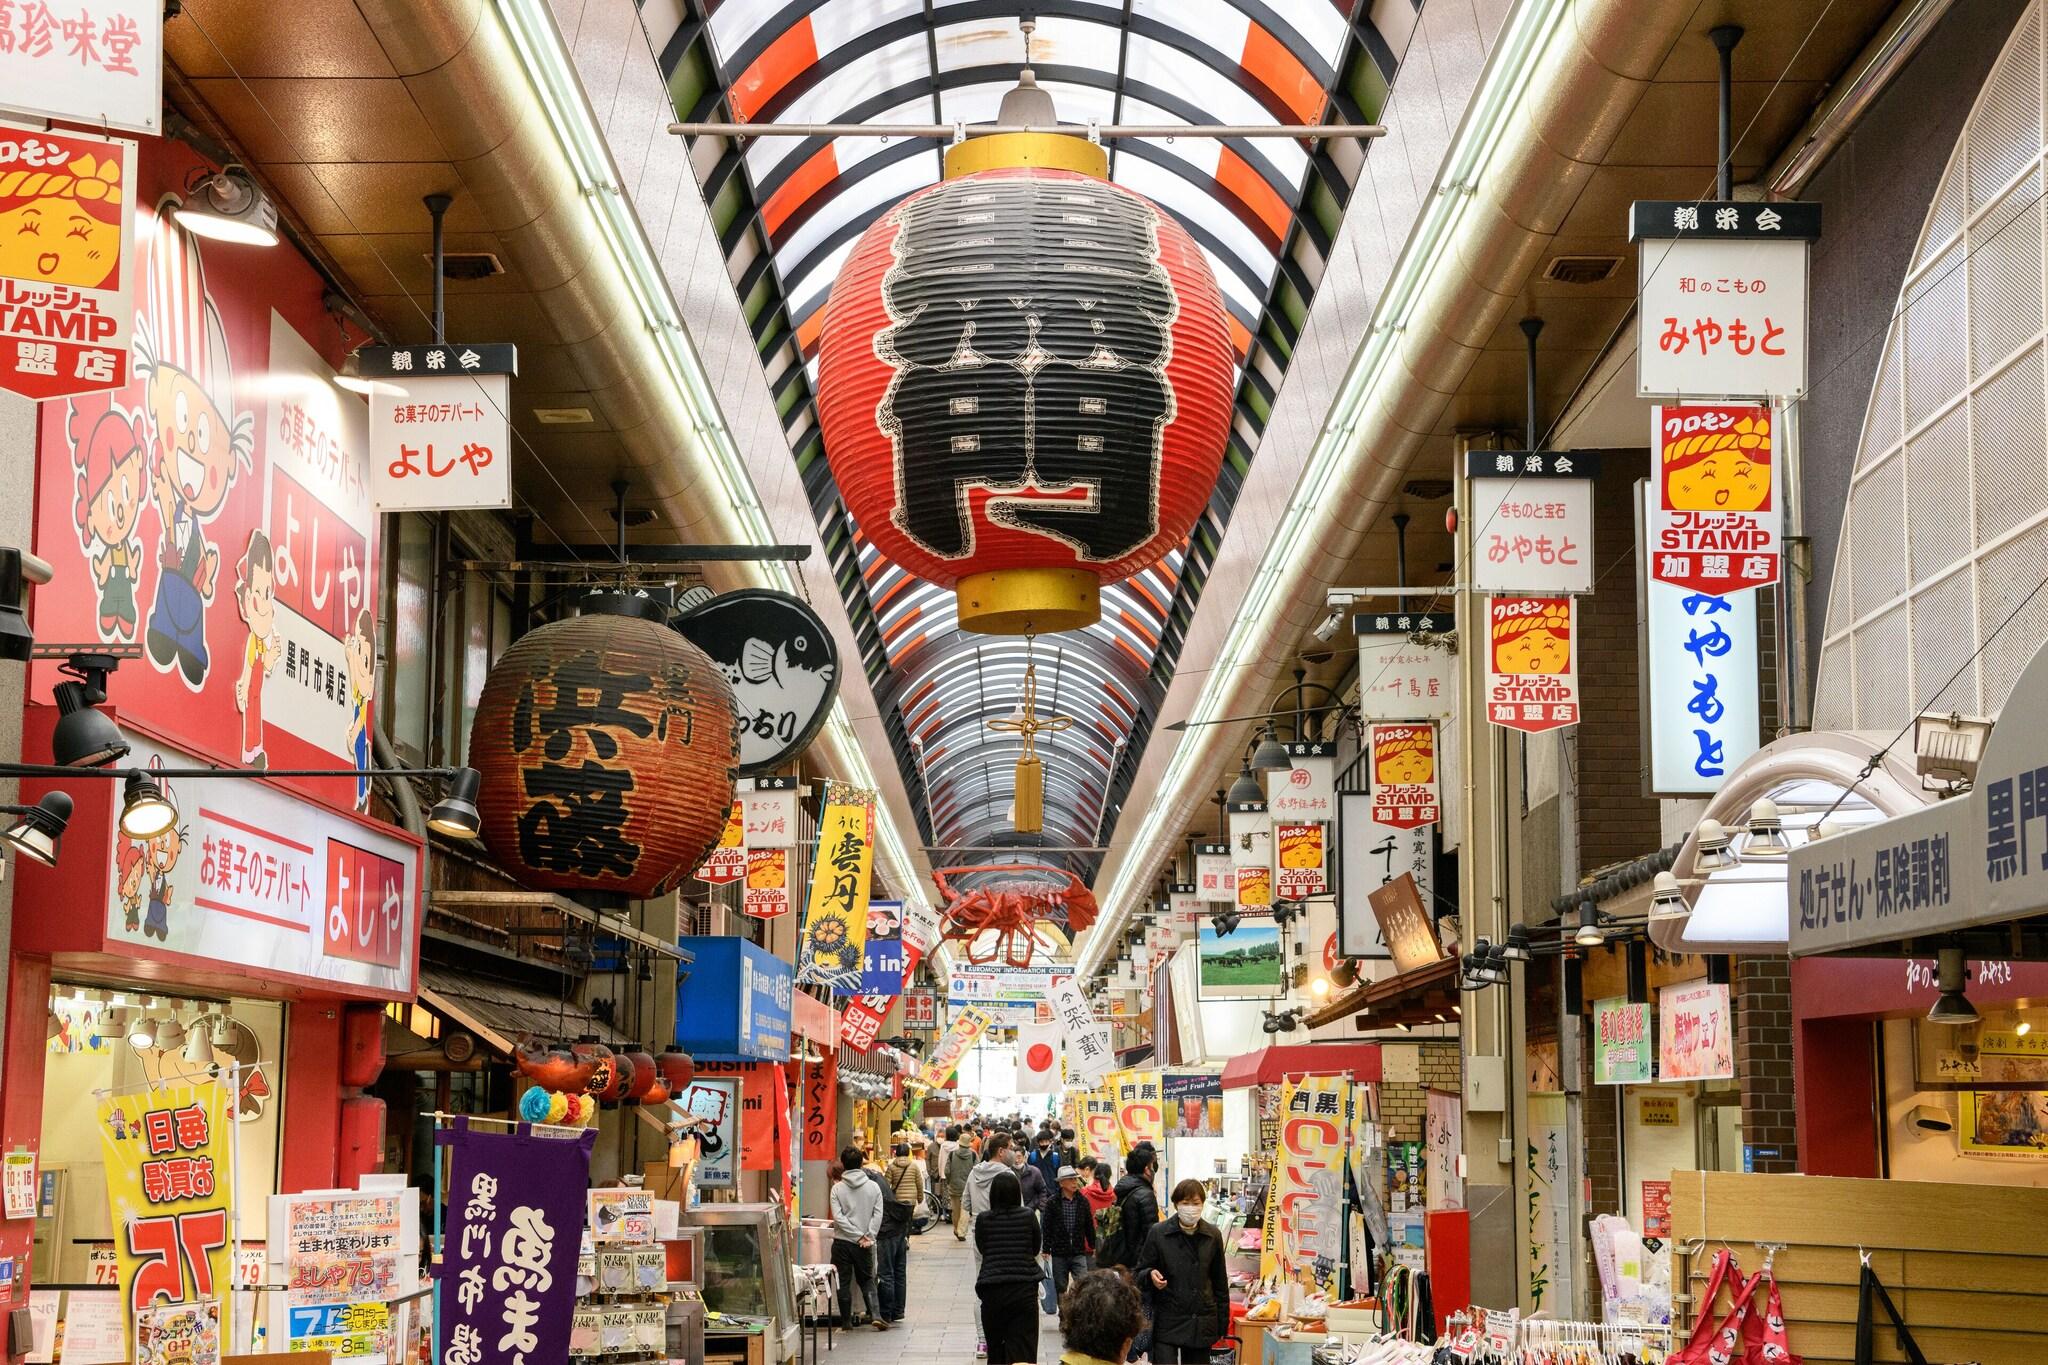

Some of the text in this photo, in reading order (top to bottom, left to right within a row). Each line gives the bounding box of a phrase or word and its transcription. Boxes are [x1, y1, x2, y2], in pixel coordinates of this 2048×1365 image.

[1673, 206, 1782, 230] 親栄会
[1679, 277, 1767, 294] 和のこもの
[1659, 317, 1786, 356] みやもと
[391, 349, 481, 371] 親栄会
[394, 402, 485, 424] お菓子のデパート
[1664, 411, 1736, 438] クロモン
[388, 443, 493, 479] よしや
[1496, 455, 1574, 473] 親栄会
[1500, 502, 1566, 519] きものと宝石
[1670, 511, 1759, 529] フレッシュ
[1661, 529, 1771, 551] STAMP
[1488, 534, 1578, 566] みやもと
[274, 493, 362, 634] よしや
[1660, 553, 1771, 579] 加盟店
[1493, 600, 1544, 621] クロモン
[1375, 617, 1434, 631] 親栄会
[285, 639, 347, 708] 黒門市場店
[1498, 674, 1562, 687] フレッシュ
[1387, 677, 1441, 698] 千鳥屋
[1492, 686, 1572, 703] STAMP
[1494, 705, 1573, 722] 加盟店
[1375, 728, 1414, 744] クロモン
[1380, 784, 1427, 794] フレッシュ
[751, 801, 781, 811] まぐろ
[1376, 793, 1435, 806] STAMP
[1376, 806, 1435, 821] 加盟店
[837, 815, 861, 830] うに
[1279, 827, 1308, 840] クロモン
[707, 855, 744, 865] TAMP
[747, 851, 773, 862] クロモン
[200, 834, 311, 912] お菓子のデパート
[698, 866, 744, 878] 加盟店
[821, 831, 866, 913] 雲丹
[1279, 875, 1323, 885] STAMP
[1283, 868, 1318, 876] フレッシュ
[1799, 831, 1950, 931] 処方せん・保険調剤
[747, 894, 786, 903] STAMP
[750, 888, 781, 896] フレッシュ
[329, 856, 401, 954] よしや
[747, 903, 786, 913] 加盟店
[1003, 966, 1046, 974] INFORMATION
[1163, 1085, 1188, 1095] Original
[1189, 1082, 1205, 1091] Fruit
[704, 1170, 731, 1180] 新魚栄
[627, 1200, 649, 1209] MASK
[298, 1234, 393, 1253] 生まれ変わります
